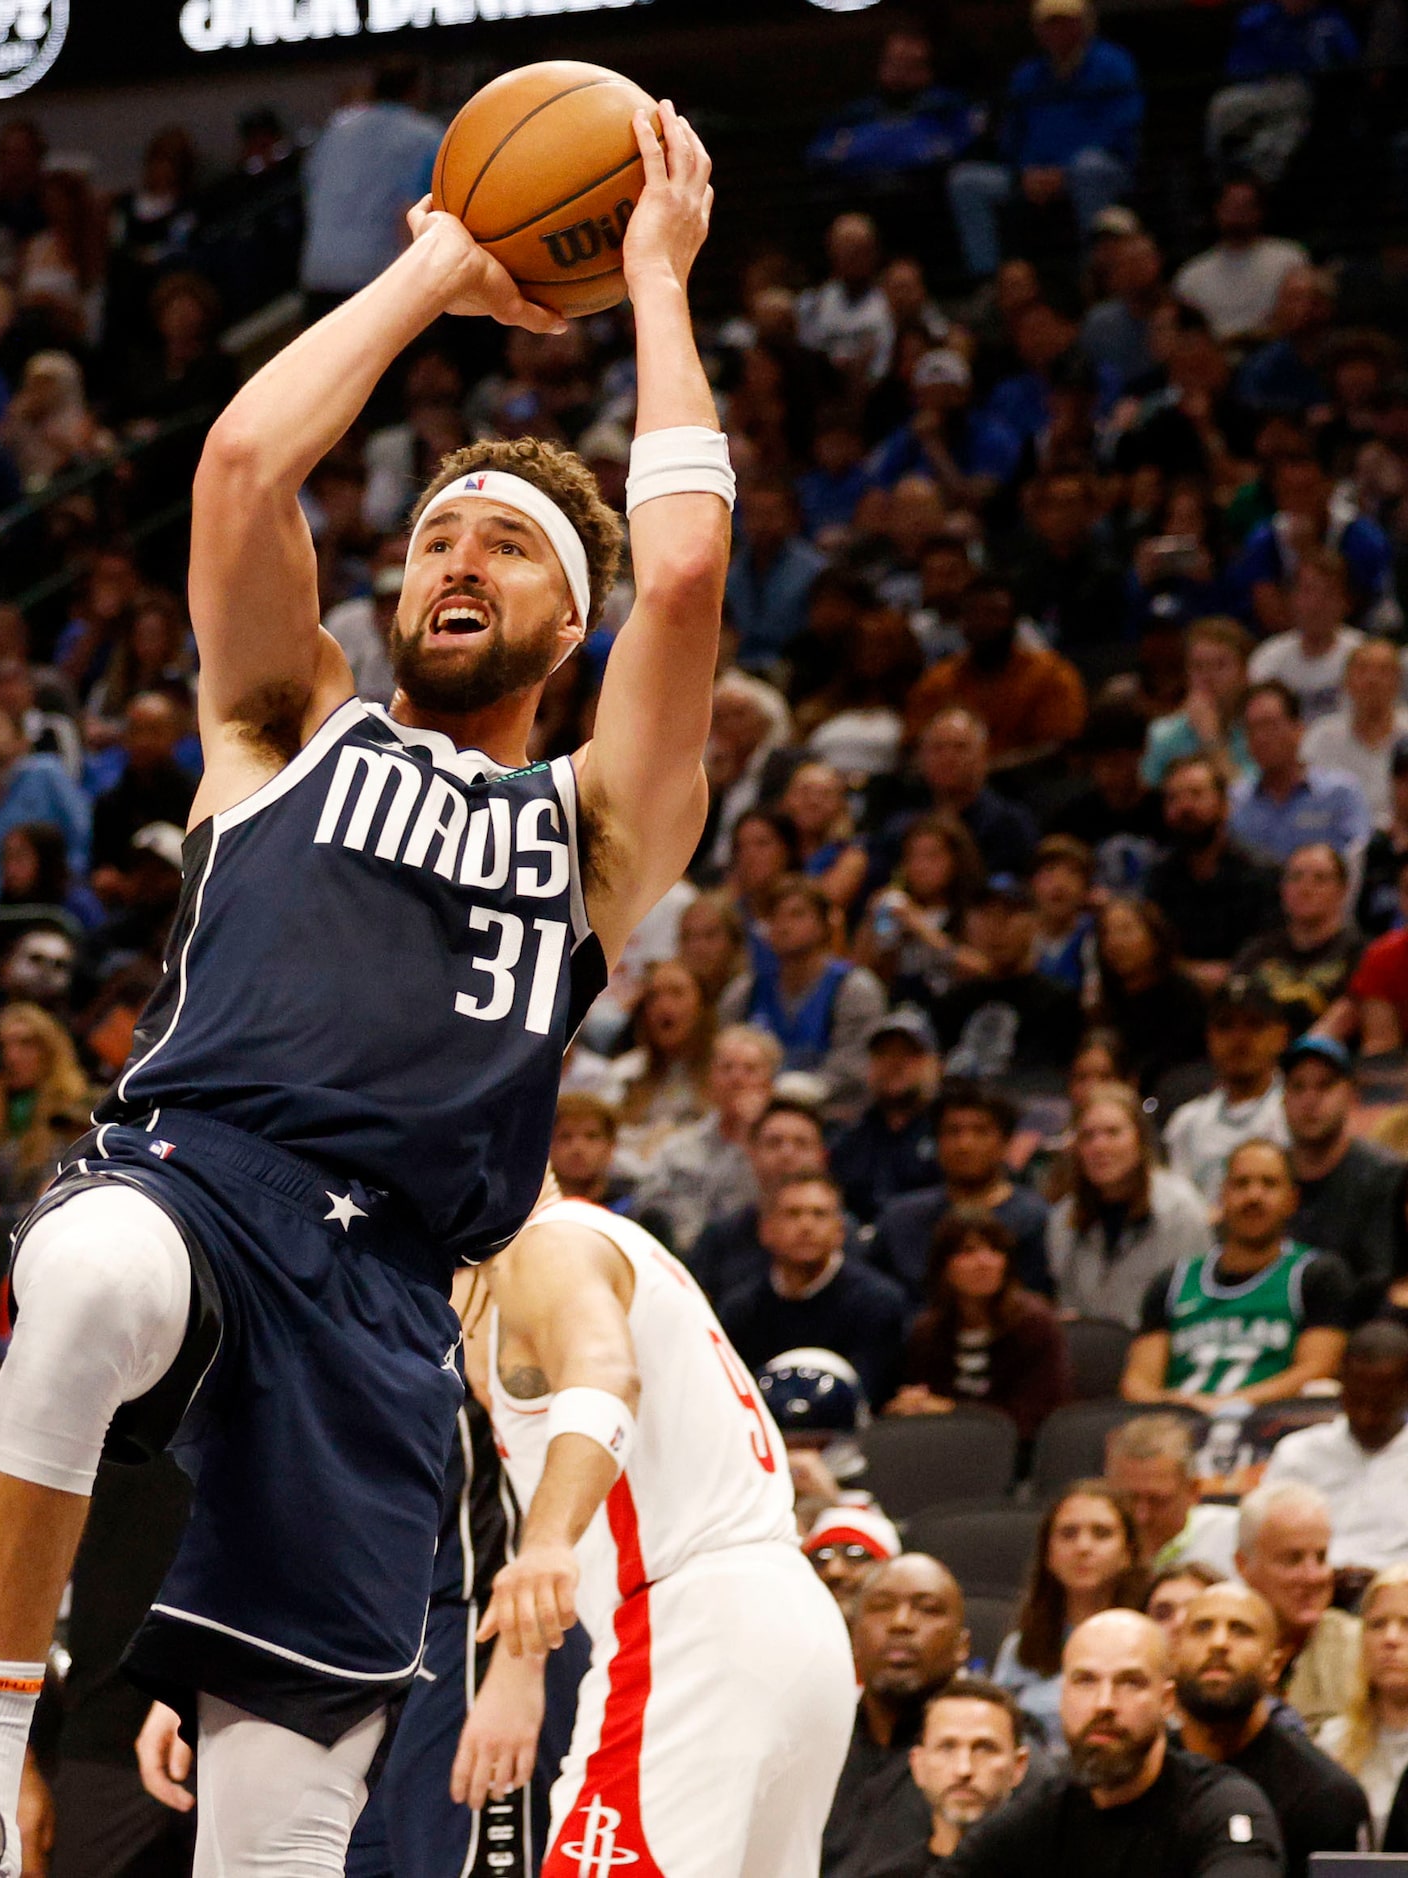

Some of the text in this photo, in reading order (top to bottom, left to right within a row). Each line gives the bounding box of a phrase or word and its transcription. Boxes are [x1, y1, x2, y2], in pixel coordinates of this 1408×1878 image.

[540, 197, 634, 268] Wil
[312, 744, 570, 899] MAVS
[454, 905, 569, 1036] 31
